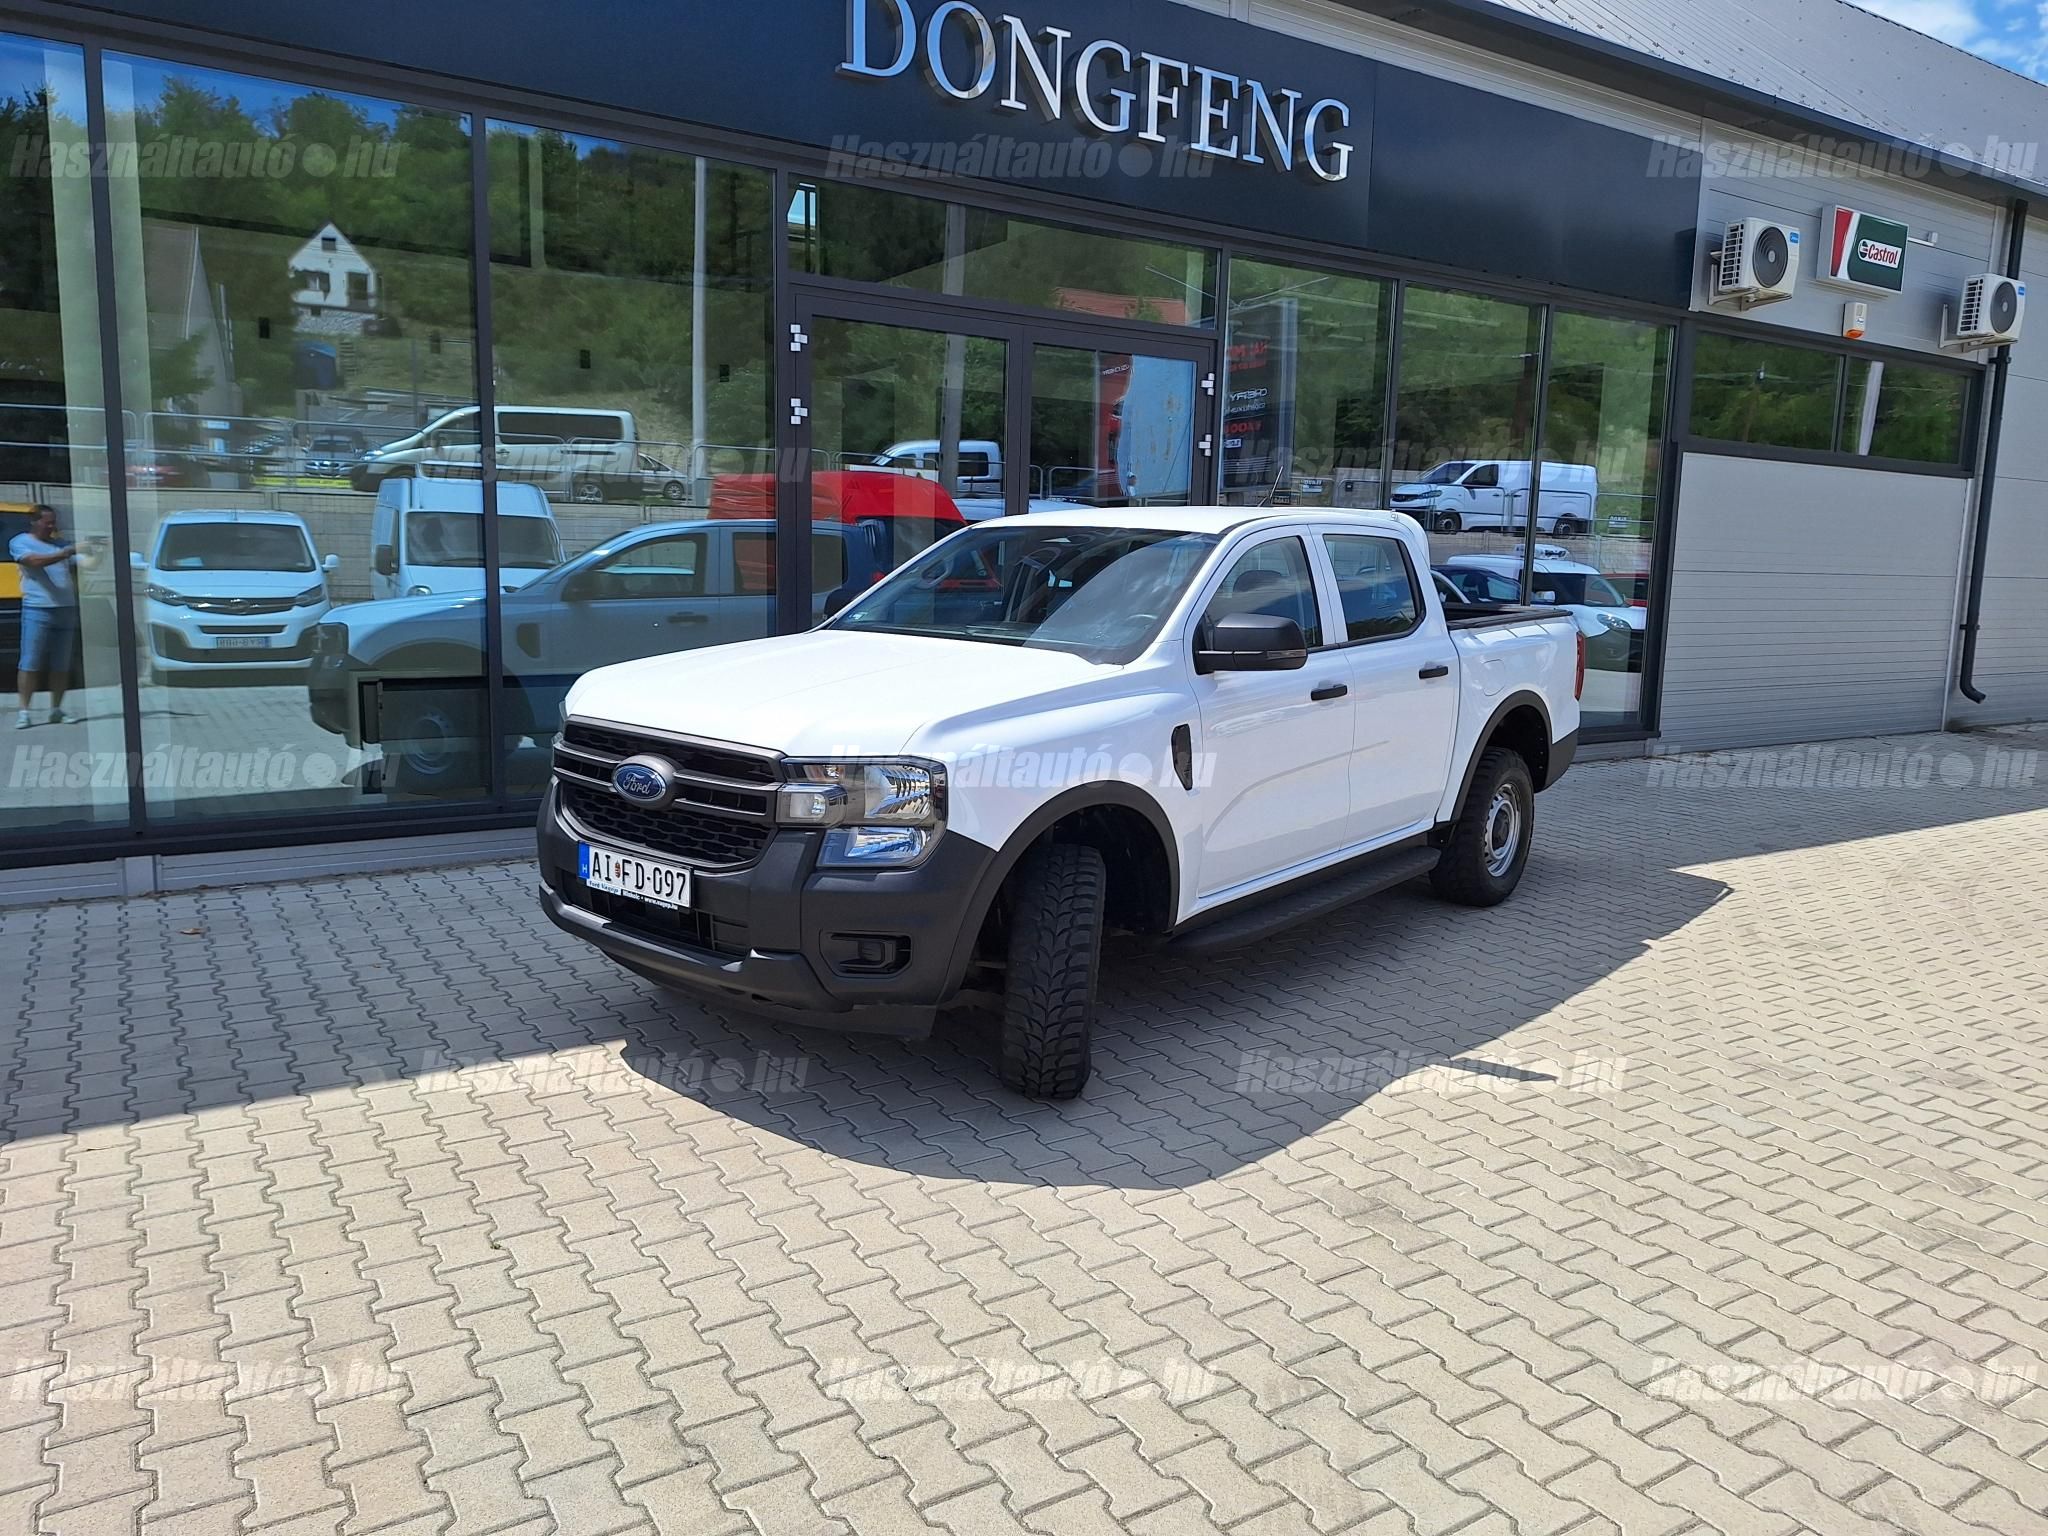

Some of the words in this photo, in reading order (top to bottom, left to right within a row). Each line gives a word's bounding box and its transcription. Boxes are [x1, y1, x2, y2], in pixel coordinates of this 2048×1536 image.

[838, 0, 1353, 181] DONGFENG
[1867, 243, 1898, 265] Castrol
[622, 772, 652, 795] Ford
[581, 863, 588, 874] H
[621, 858, 686, 901] FD-097
